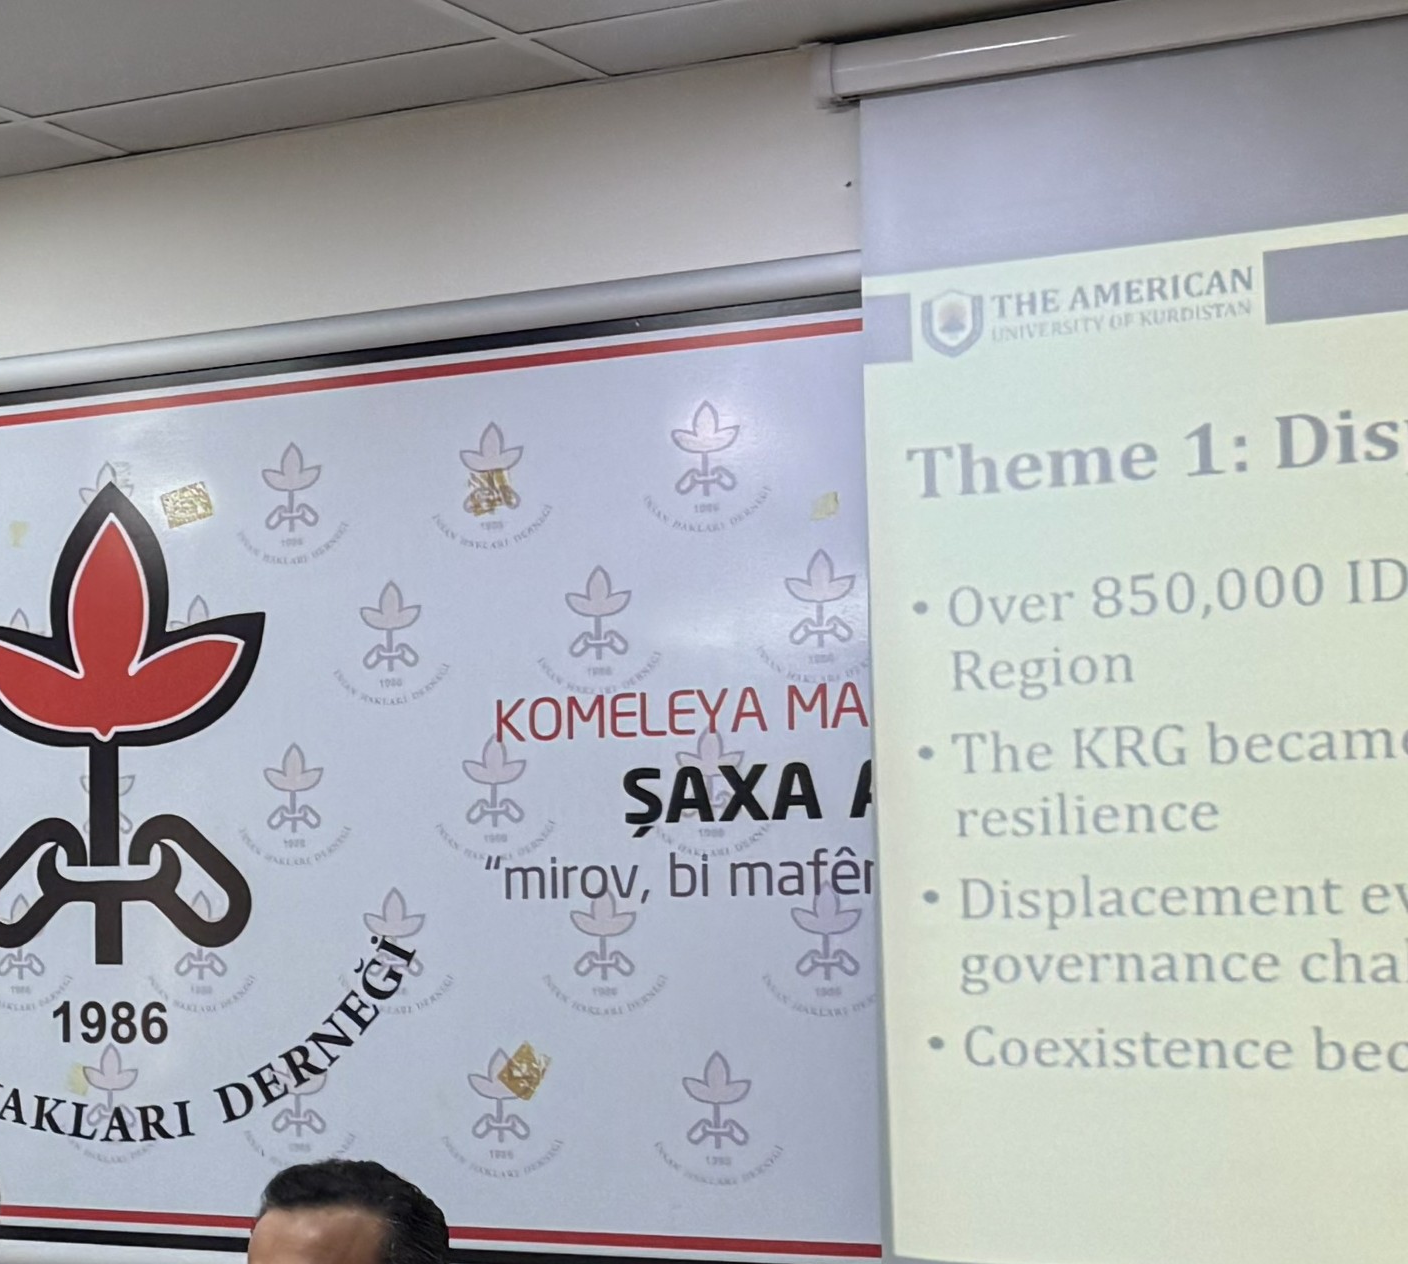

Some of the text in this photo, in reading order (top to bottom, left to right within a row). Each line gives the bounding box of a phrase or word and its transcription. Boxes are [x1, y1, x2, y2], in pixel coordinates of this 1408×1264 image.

[991, 266, 1253, 320] THE AMERICAN
[991, 298, 1252, 344] UNIVERSITY OF KURDISTAN
[906, 409, 1408, 499] Theme 1: Dis
[948, 585, 1075, 628] Over
[1091, 562, 1324, 620] 850,000
[950, 646, 1135, 701] Region
[496, 686, 768, 743] KOMELEYA
[950, 721, 1408, 774] The KRG becam
[623, 761, 822, 838] ŞAXA
[955, 792, 1221, 838] resilience
[669, 852, 709, 898] bi
[958, 873, 1344, 930] Displacement
[959, 937, 1408, 996] governance cha
[52, 1000, 168, 1045] 1986
[213, 934, 416, 1125] DERNEĞİ
[963, 1025, 1294, 1070] Coexistence
